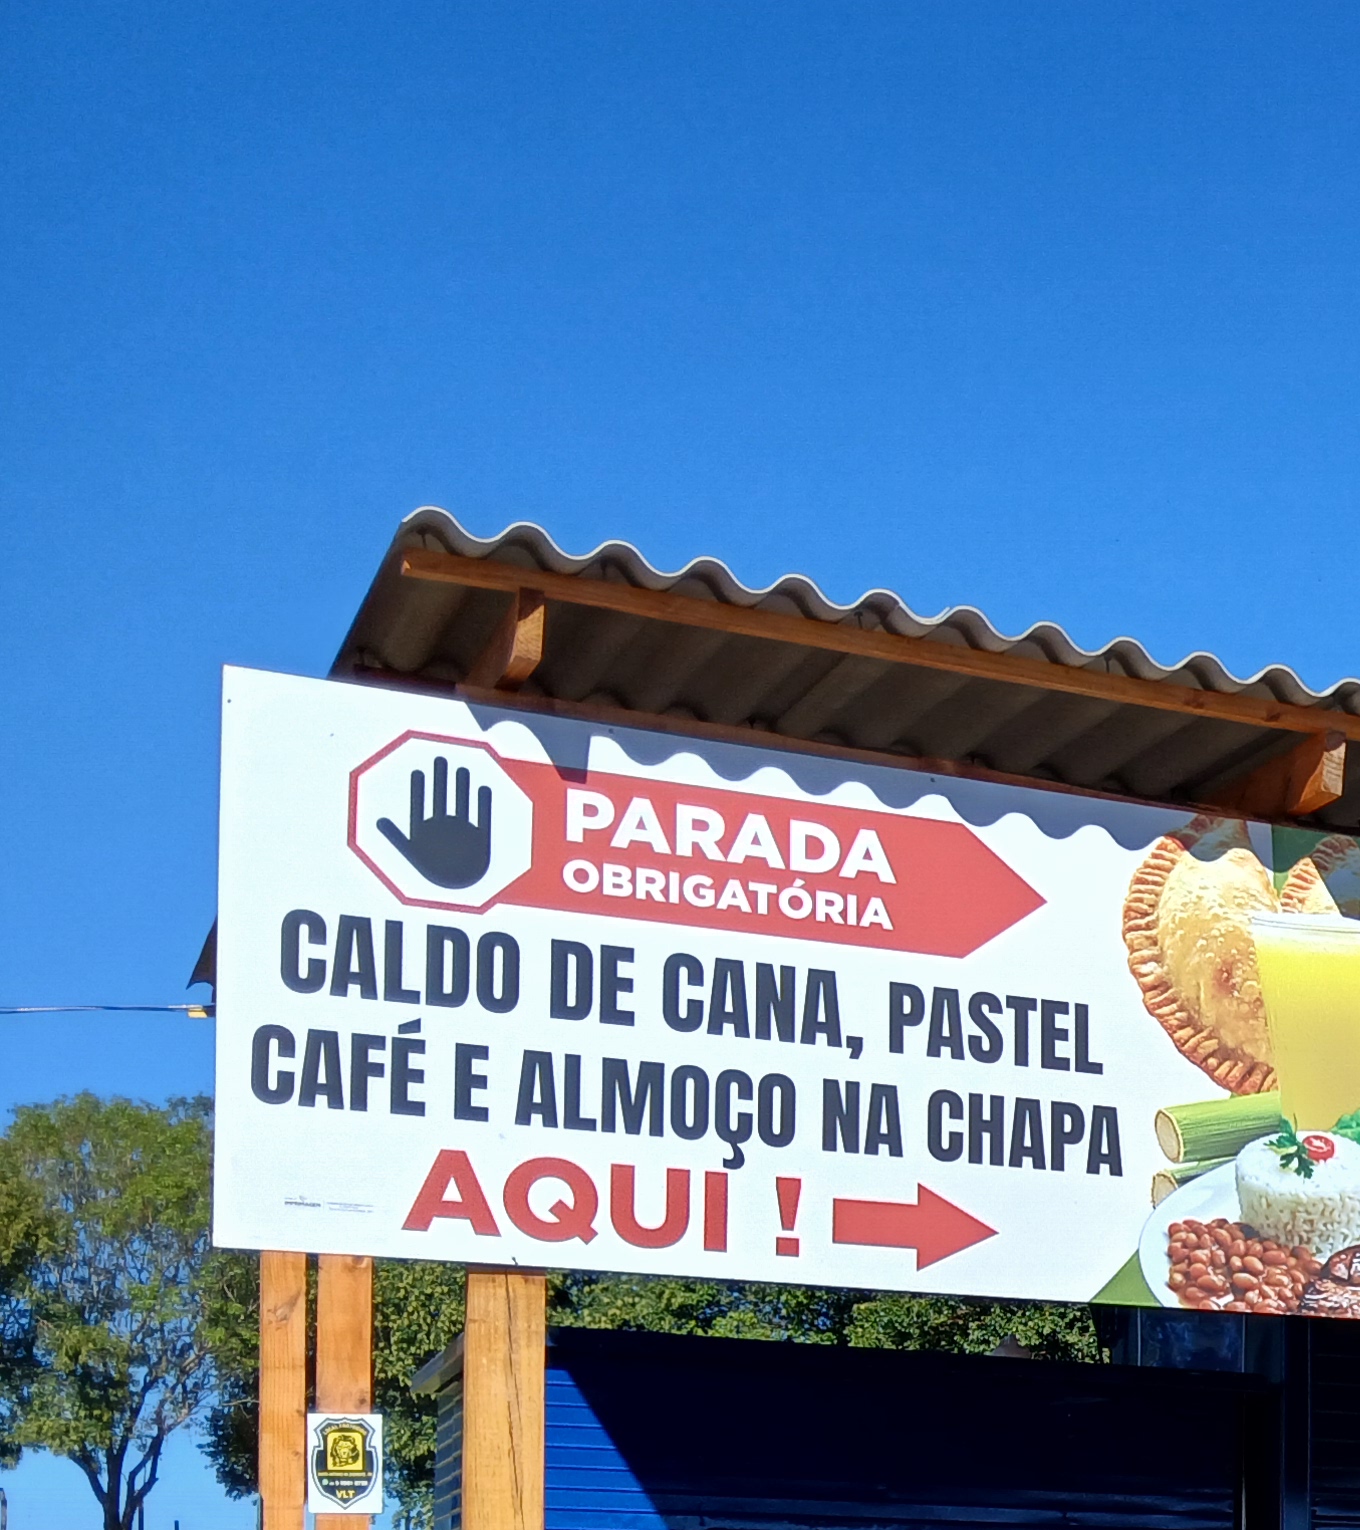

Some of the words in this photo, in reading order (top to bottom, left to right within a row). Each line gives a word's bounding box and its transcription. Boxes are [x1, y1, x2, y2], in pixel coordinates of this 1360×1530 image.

[564, 787, 898, 886] PARADA
[561, 857, 895, 932] OBRIGATÓRIA
[279, 908, 520, 1014] CALDO
[550, 938, 635, 1028] DE
[662, 952, 865, 1060] CANA,
[888, 981, 1104, 1076] PASTEL
[249, 1016, 427, 1118] CAFÉ
[453, 1043, 490, 1122] E
[514, 1049, 798, 1170] ALMOÇO
[822, 1079, 904, 1159] NA
[926, 1090, 1124, 1178] CHAPA
[403, 1148, 727, 1253] AQUI
[336, 1490, 355, 1499] VLT
